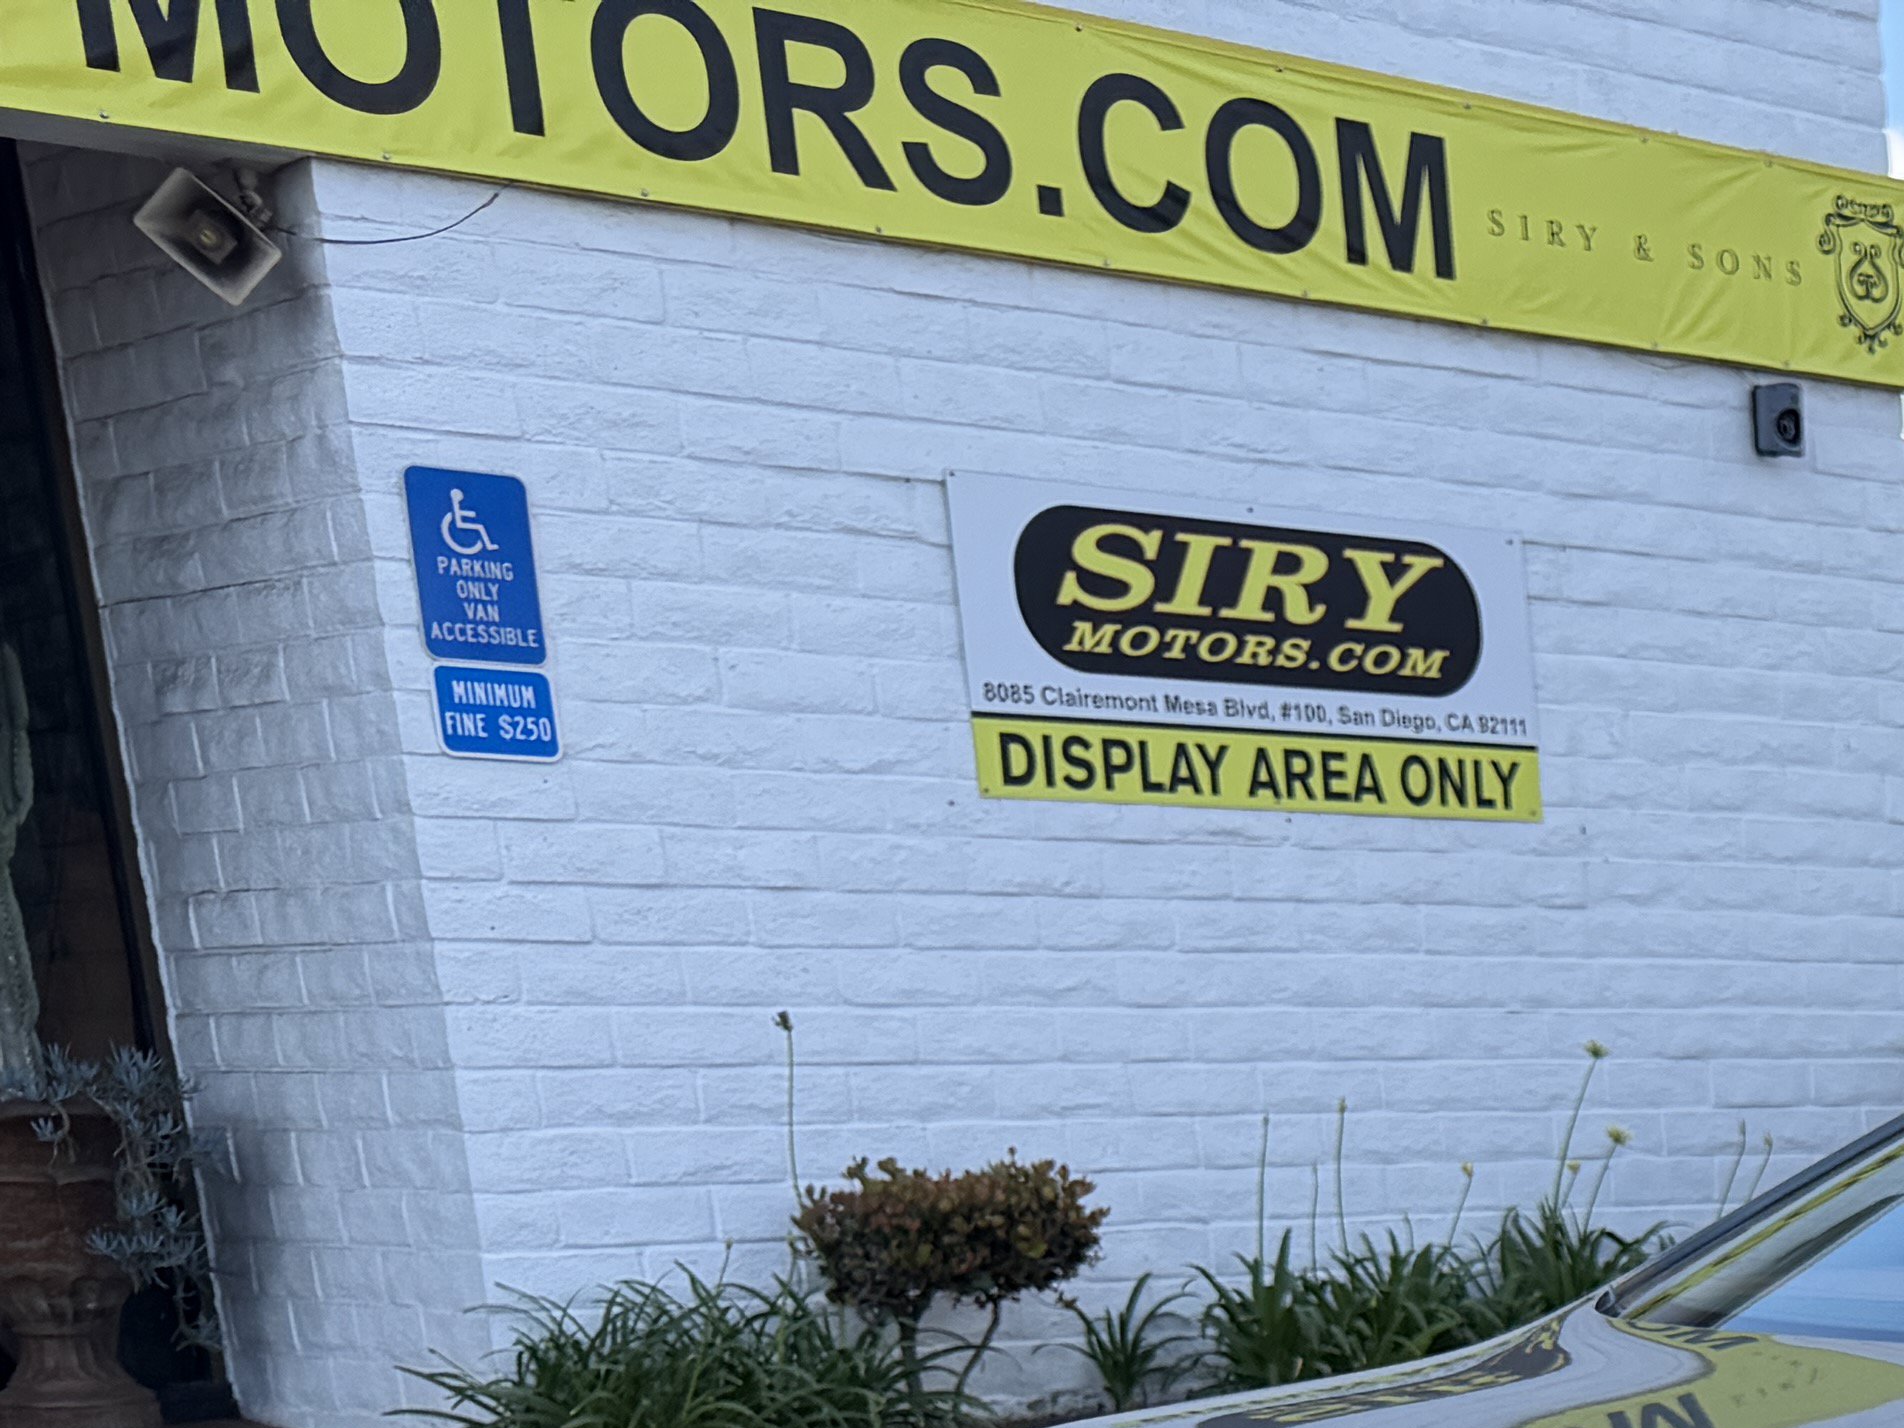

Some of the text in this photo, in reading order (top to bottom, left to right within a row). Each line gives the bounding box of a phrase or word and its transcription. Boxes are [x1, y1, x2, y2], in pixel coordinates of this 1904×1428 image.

[1487, 208, 1802, 287] SIRY & SONS
[436, 555, 514, 582] PARKING
[1056, 523, 1445, 633] SIRY
[456, 580, 499, 602] ONLY
[463, 602, 499, 622] VAN
[430, 622, 539, 649] ACCESSIBLE
[1062, 620, 1450, 679] MOTORS.COM
[451, 679, 536, 709] MINIMUM
[983, 681, 1035, 705] 8085
[1040, 685, 1159, 712] Clairemont
[1164, 694, 1218, 717] Mesa
[1224, 697, 1276, 722] Blvd,
[1280, 702, 1333, 726] #100,
[1337, 705, 1376, 727] San
[1380, 707, 1442, 734] Diego,
[1445, 713, 1475, 733] CA
[444, 711, 552, 742] FINE $250
[998, 732, 1521, 811] DISPLAY AREA ONLY
